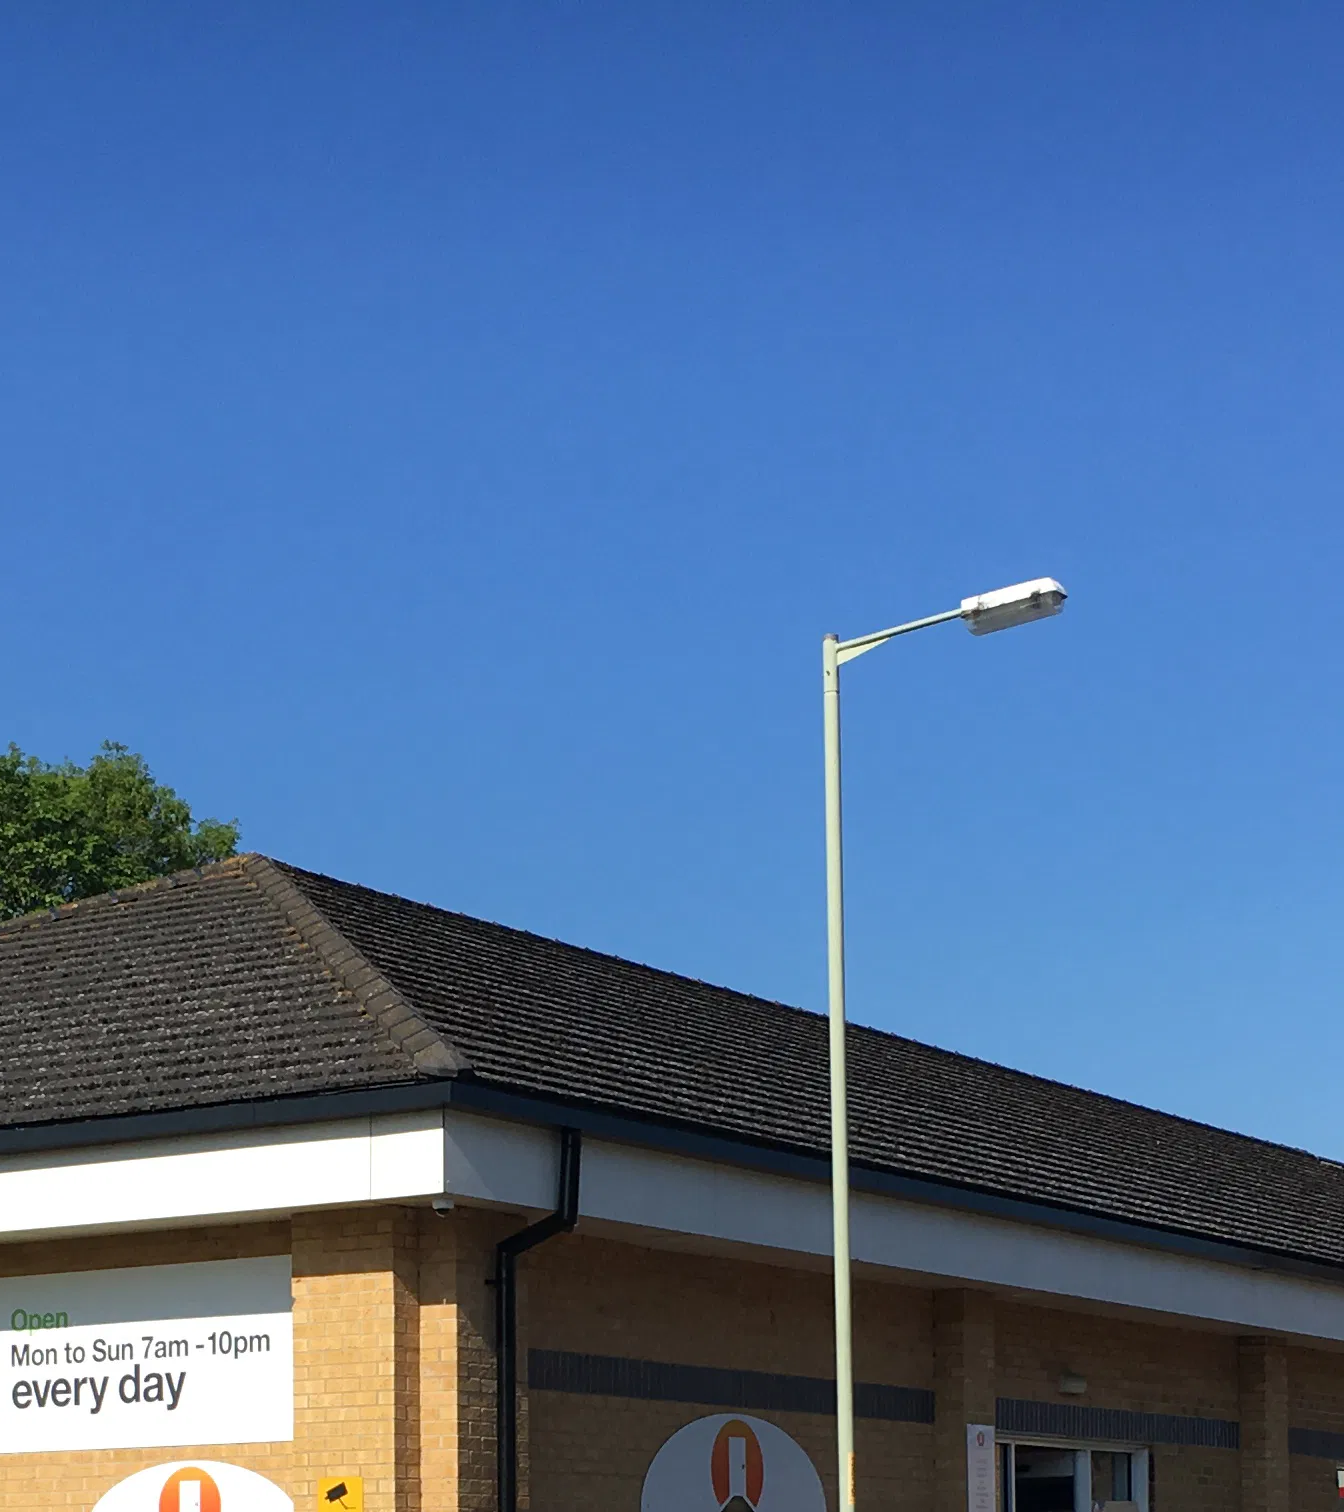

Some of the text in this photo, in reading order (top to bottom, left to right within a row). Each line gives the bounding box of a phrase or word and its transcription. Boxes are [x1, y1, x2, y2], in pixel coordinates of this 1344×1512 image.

[11, 1309, 69, 1335] Open
[11, 1344, 58, 1367] Mon
[64, 1342, 86, 1364] to
[92, 1338, 134, 1362] Sun
[141, 1336, 189, 1359] 7am
[12, 1364, 187, 1414] every day
